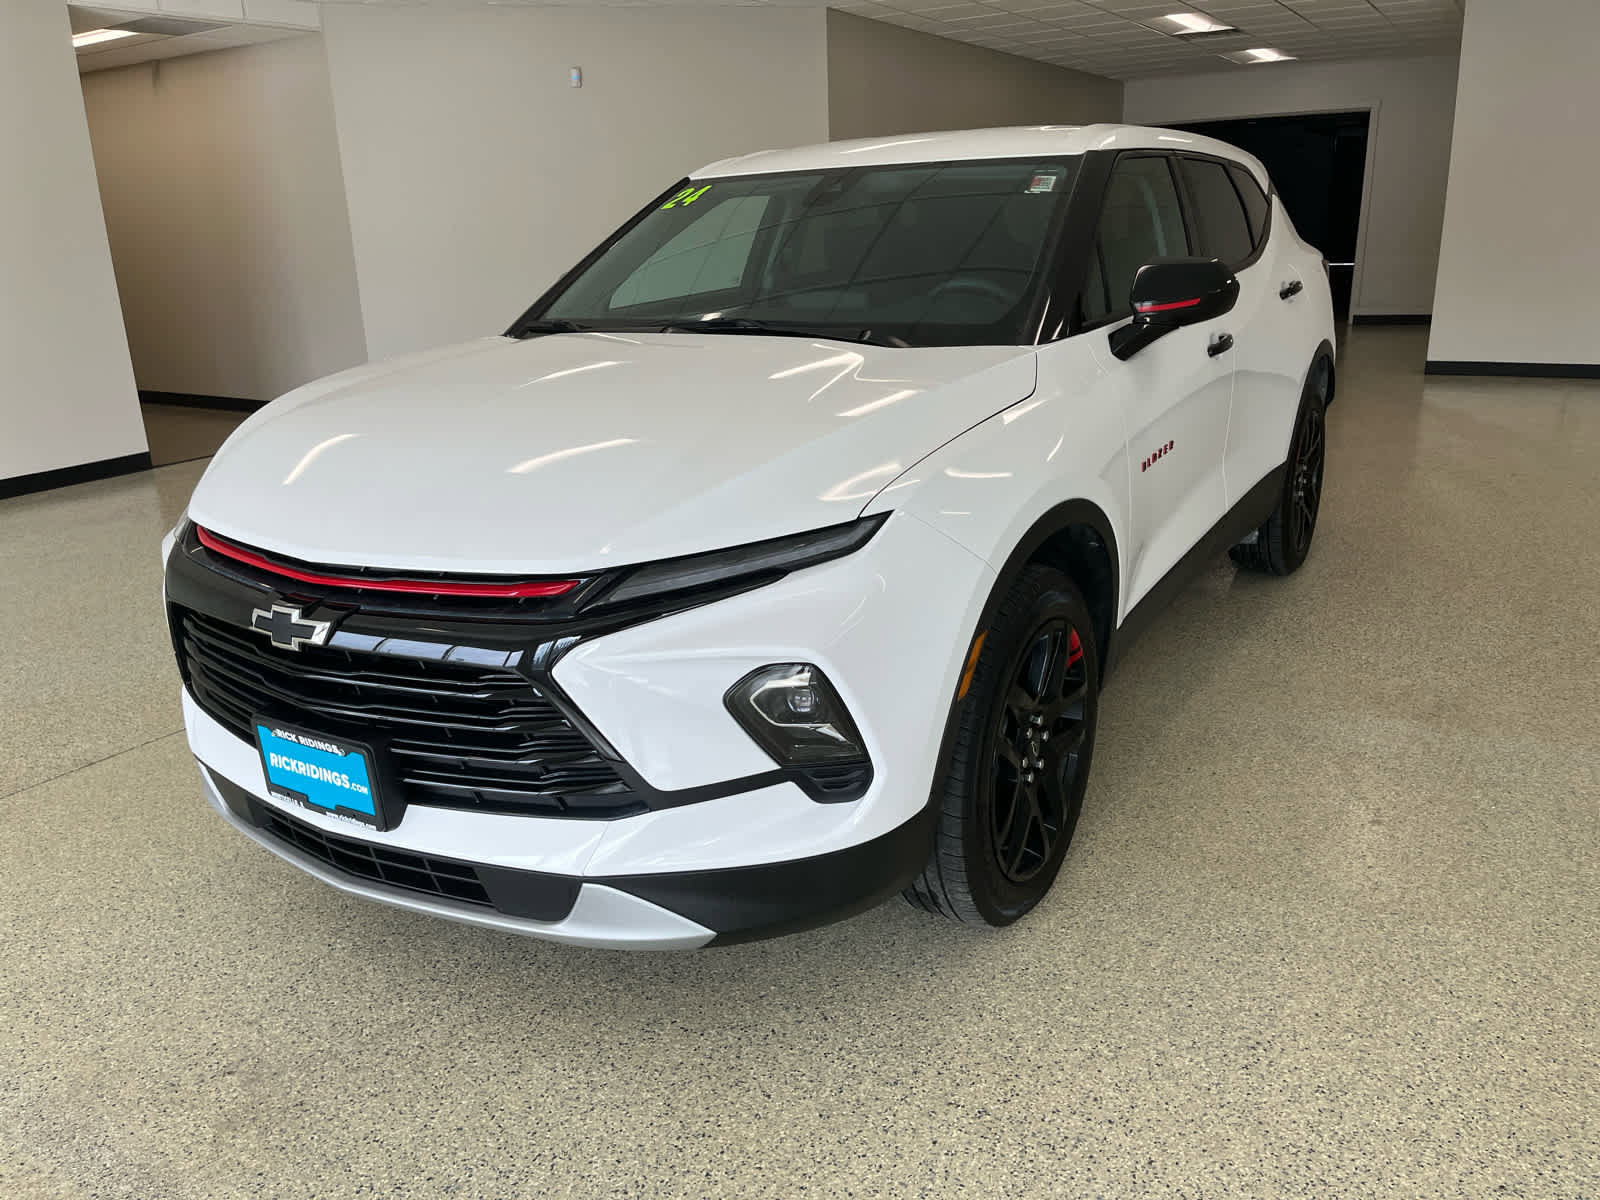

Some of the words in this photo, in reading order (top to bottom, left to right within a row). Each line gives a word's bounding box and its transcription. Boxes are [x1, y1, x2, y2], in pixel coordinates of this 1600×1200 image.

[660, 185, 712, 210] 24
[1141, 440, 1174, 472] BLAZER
[276, 728, 299, 744] RICK
[298, 735, 340, 755] RIDINGS
